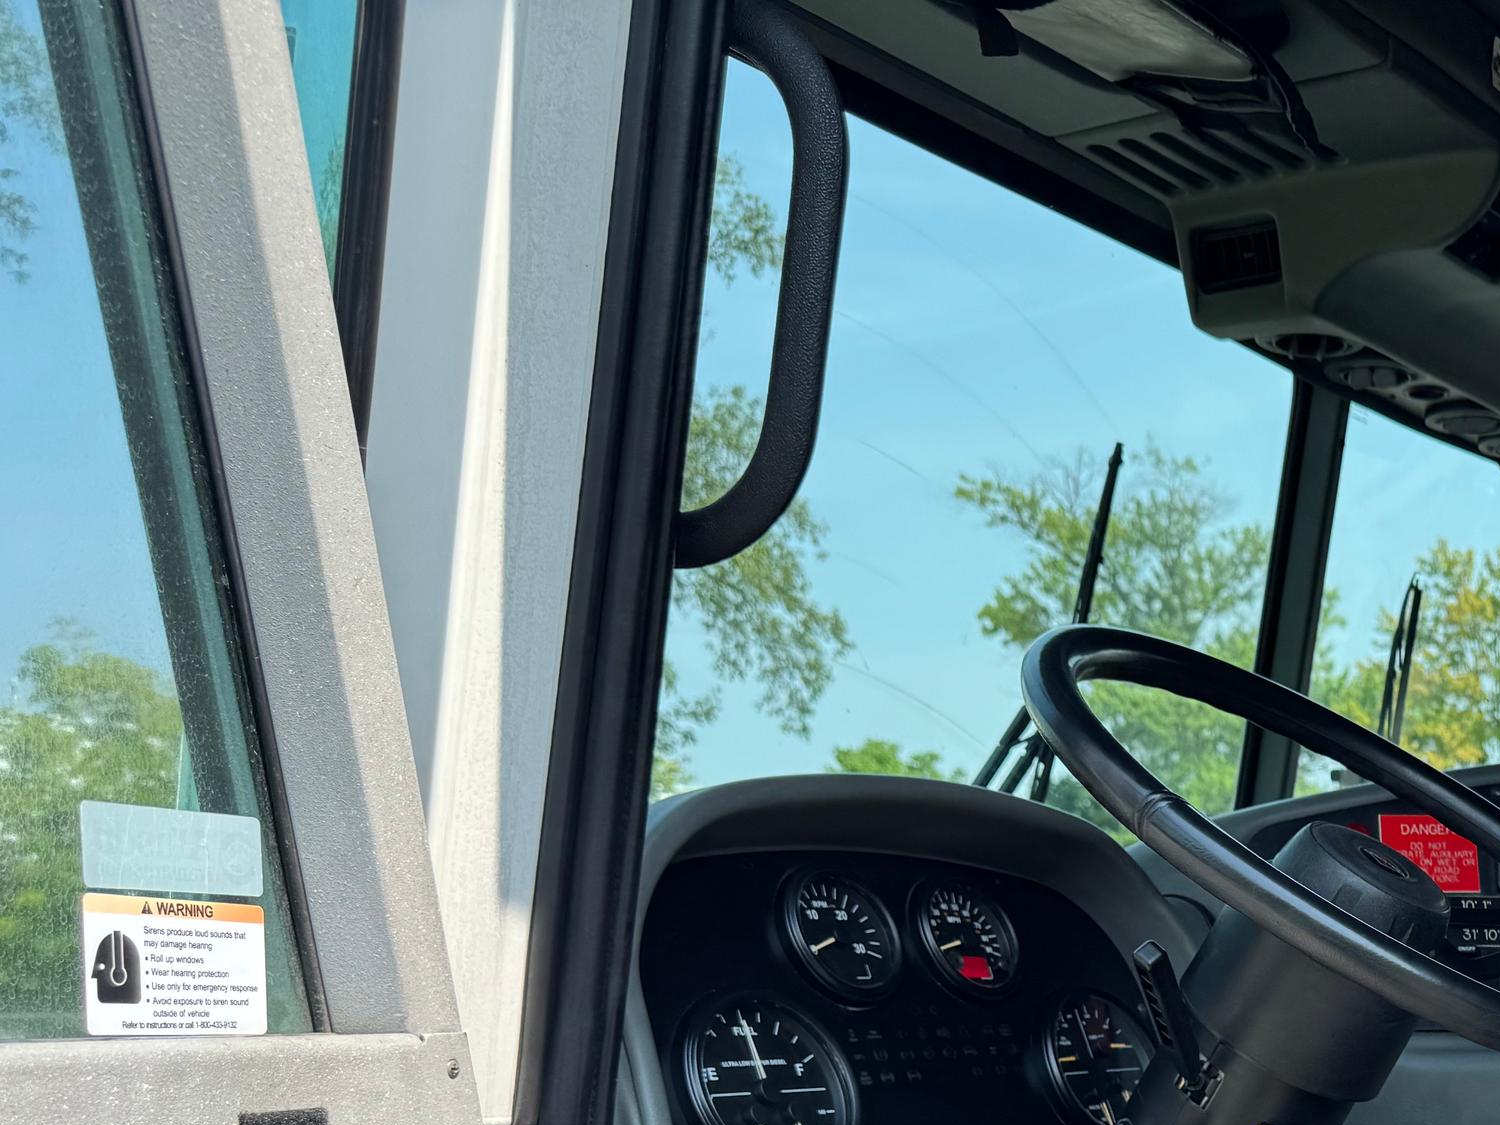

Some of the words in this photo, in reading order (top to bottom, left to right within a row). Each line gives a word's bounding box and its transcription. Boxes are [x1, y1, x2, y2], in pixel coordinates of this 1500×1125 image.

[1410, 842, 1423, 850] DO
[1428, 842, 1447, 850] NOT
[156, 901, 214, 918] WARNING
[805, 909, 819, 920] 10
[834, 910, 848, 921] 20
[143, 926, 165, 935] Sirens
[166, 928, 193, 938] produce
[194, 929, 209, 938] loud
[210, 930, 233, 939] sounds
[144, 940, 158, 949] may
[160, 940, 187, 950] damage
[188, 941, 213, 952] hearing
[852, 943, 866, 954] 30
[150, 954, 164, 963] Roll
[165, 956, 174, 964] up
[176, 955, 205, 964] windows
[151, 968, 170, 977] Wear
[171, 969, 196, 979] hearing
[198, 970, 230, 979] protection
[151, 982, 165, 991] Use
[167, 982, 181, 993] only
[182, 982, 191, 991] for
[193, 984, 229, 994] emergency
[229, 985, 258, 994] response
[152, 996, 172, 1005] Avoid
[173, 998, 203, 1006] exposure
[204, 998, 212, 1006] to
[212, 998, 229, 1006] siren
[229, 998, 249, 1006] sound
[152, 1009, 178, 1018] outside
[179, 1009, 186, 1018] of
[187, 1009, 210, 1018] vehicle
[122, 1021, 138, 1029] Refer
[139, 1021, 145, 1029] to
[146, 1020, 177, 1029] instructions
[178, 1021, 184, 1029] or
[185, 1020, 194, 1029] call
[731, 1026, 758, 1036] FUL
[793, 1063, 804, 1077] F
